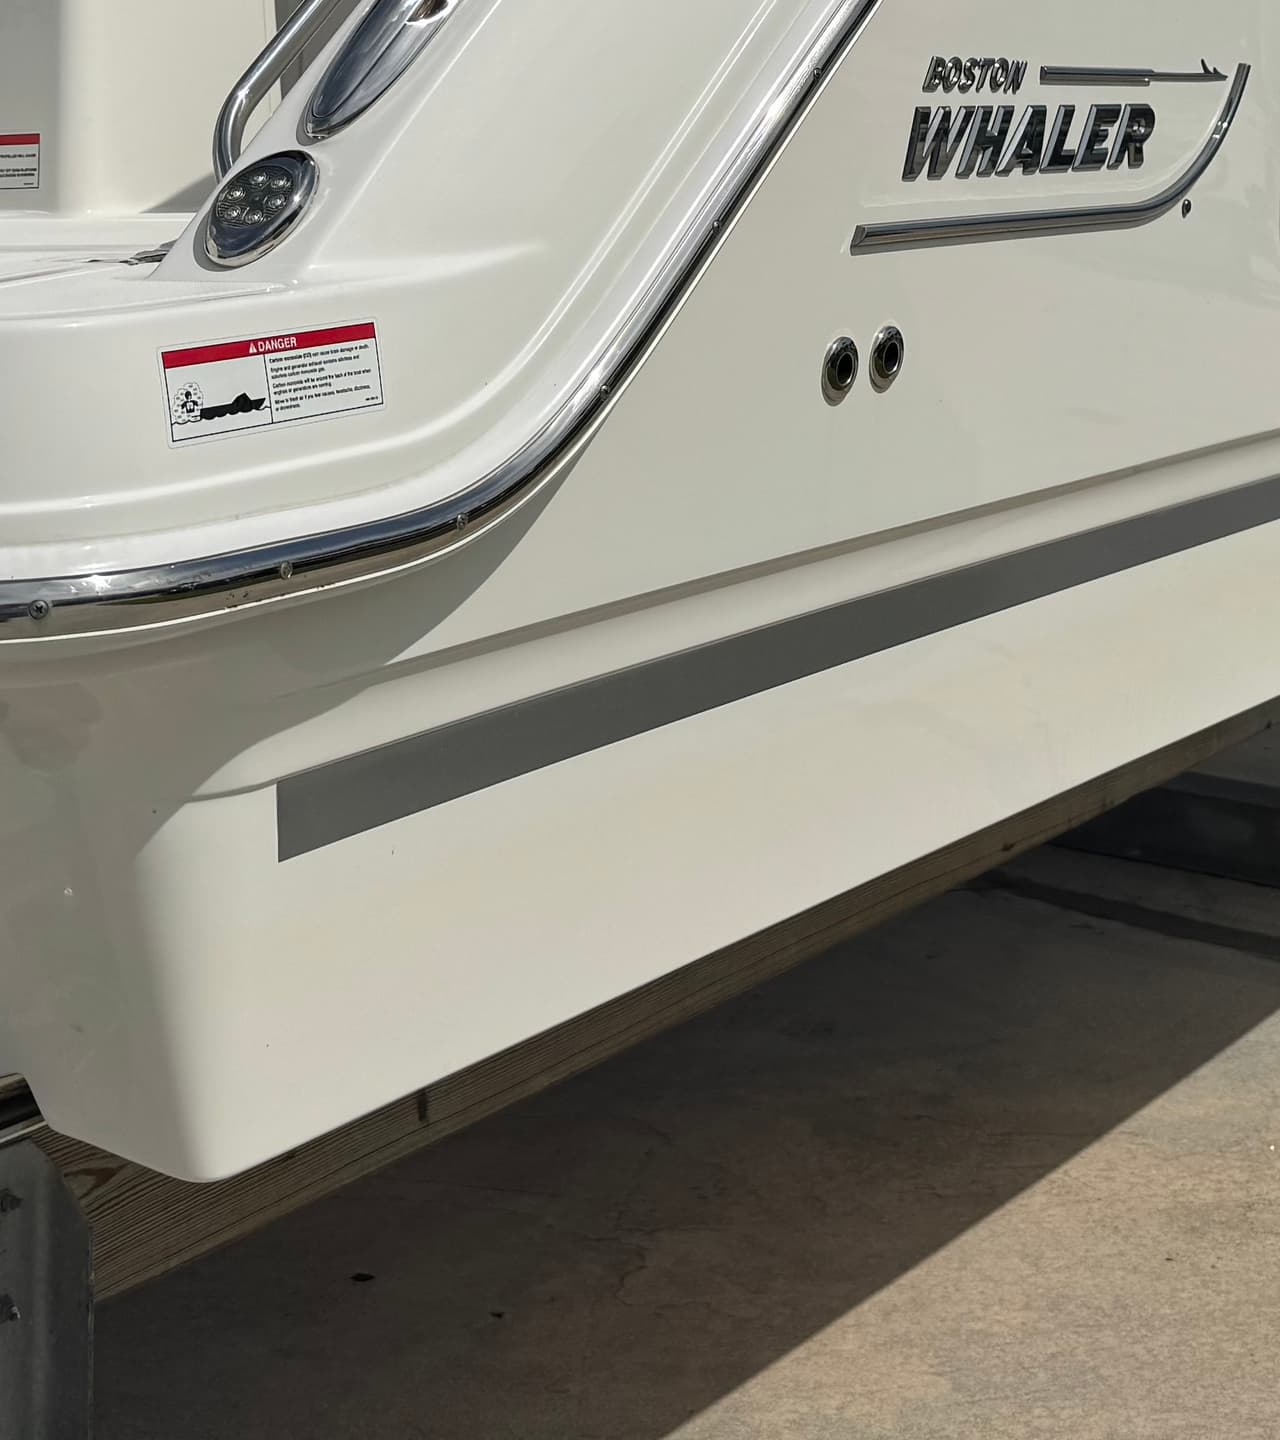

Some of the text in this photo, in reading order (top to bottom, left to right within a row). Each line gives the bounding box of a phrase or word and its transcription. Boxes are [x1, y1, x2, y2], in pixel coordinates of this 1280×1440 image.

[922, 56, 1028, 94] BOSTON
[901, 103, 1156, 182] WHALER
[258, 336, 297, 352] DANGER
